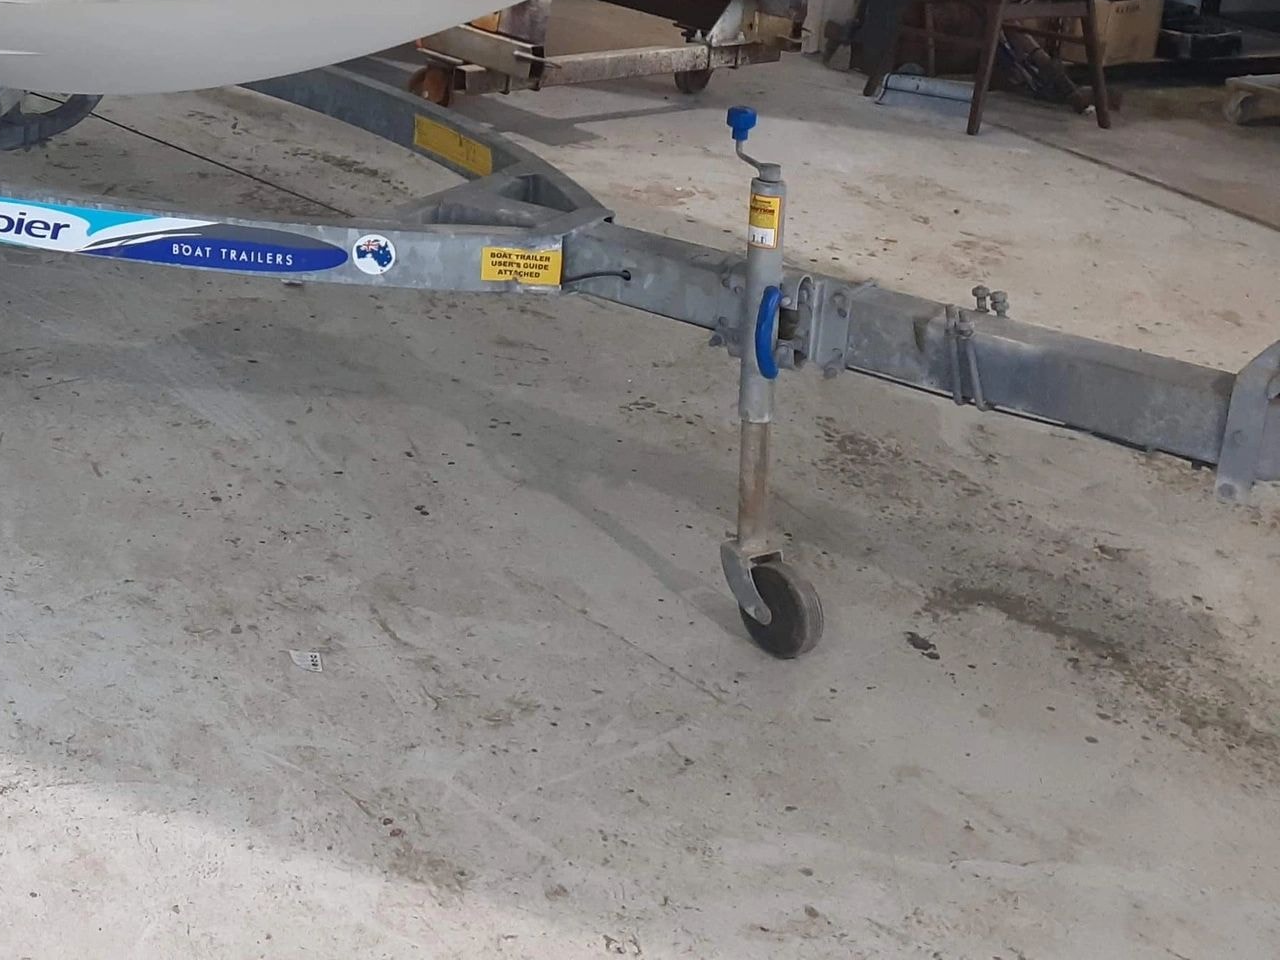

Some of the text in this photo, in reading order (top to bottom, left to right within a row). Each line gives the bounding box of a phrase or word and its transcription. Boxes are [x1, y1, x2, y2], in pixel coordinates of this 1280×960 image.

[172, 243, 294, 266] BOAT TRAILERS
[515, 254, 551, 263] TRAILER
[491, 260, 549, 271] USER'S GUIDE
